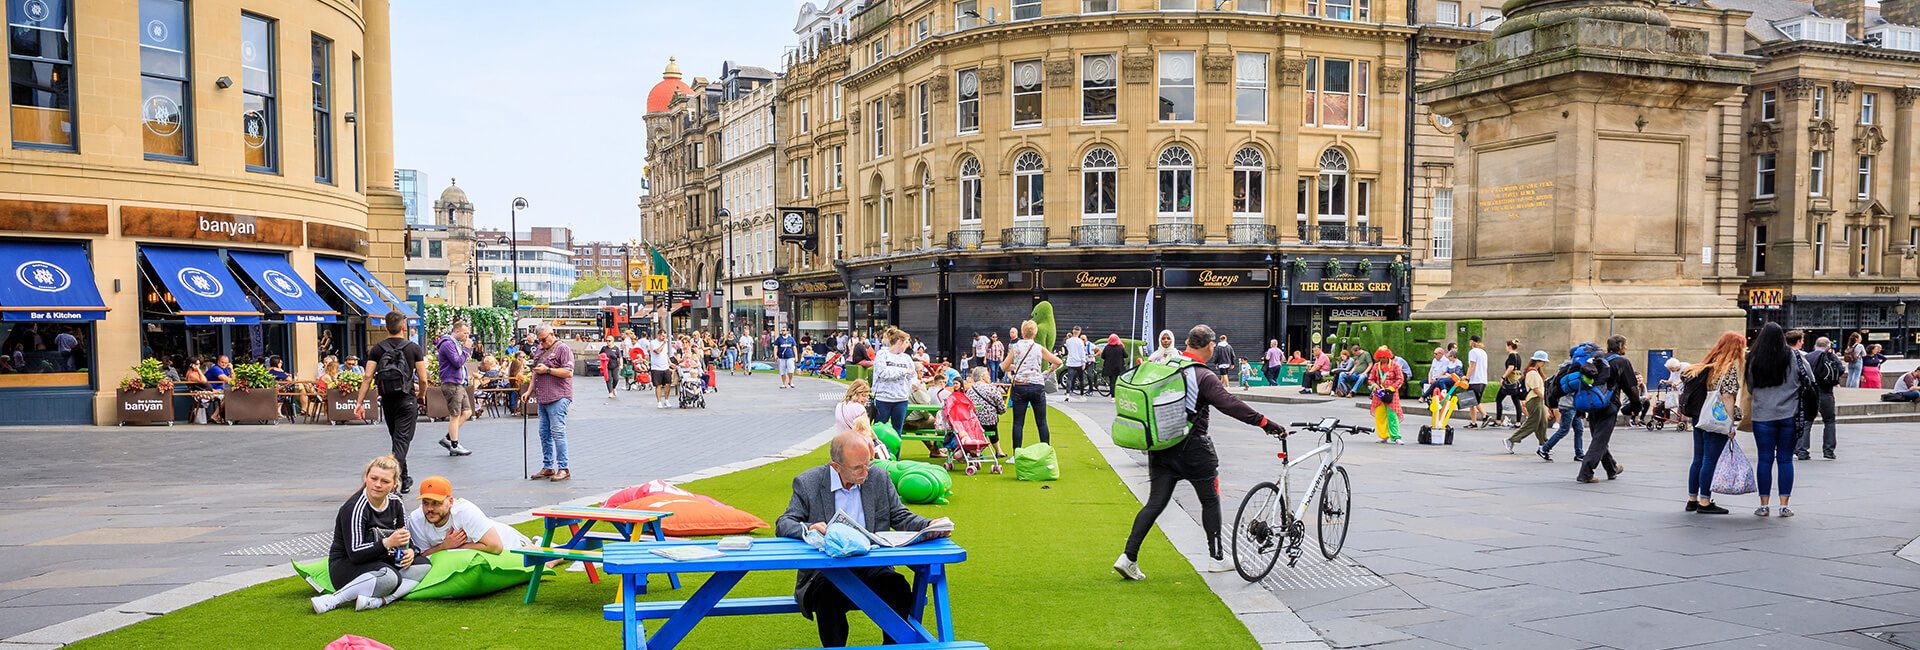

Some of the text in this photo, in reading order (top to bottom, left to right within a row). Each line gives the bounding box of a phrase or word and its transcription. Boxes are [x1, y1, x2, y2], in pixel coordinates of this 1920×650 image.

[199, 216, 255, 237] banyan
[650, 278, 664, 290] M
[972, 273, 1004, 289] Berrys
[1075, 271, 1118, 288] Berrys
[1198, 269, 1240, 287] Berrys
[1300, 282, 1393, 292] THE CHARLES GREY
[1873, 286, 1900, 294] BYRON
[1331, 309, 1386, 317] BASEMENT
[209, 315, 236, 324] banyan
[124, 401, 163, 412] banyan
[335, 401, 371, 411] bann
[1119, 398, 1138, 413] eats
[1304, 464, 1328, 506] boardman
